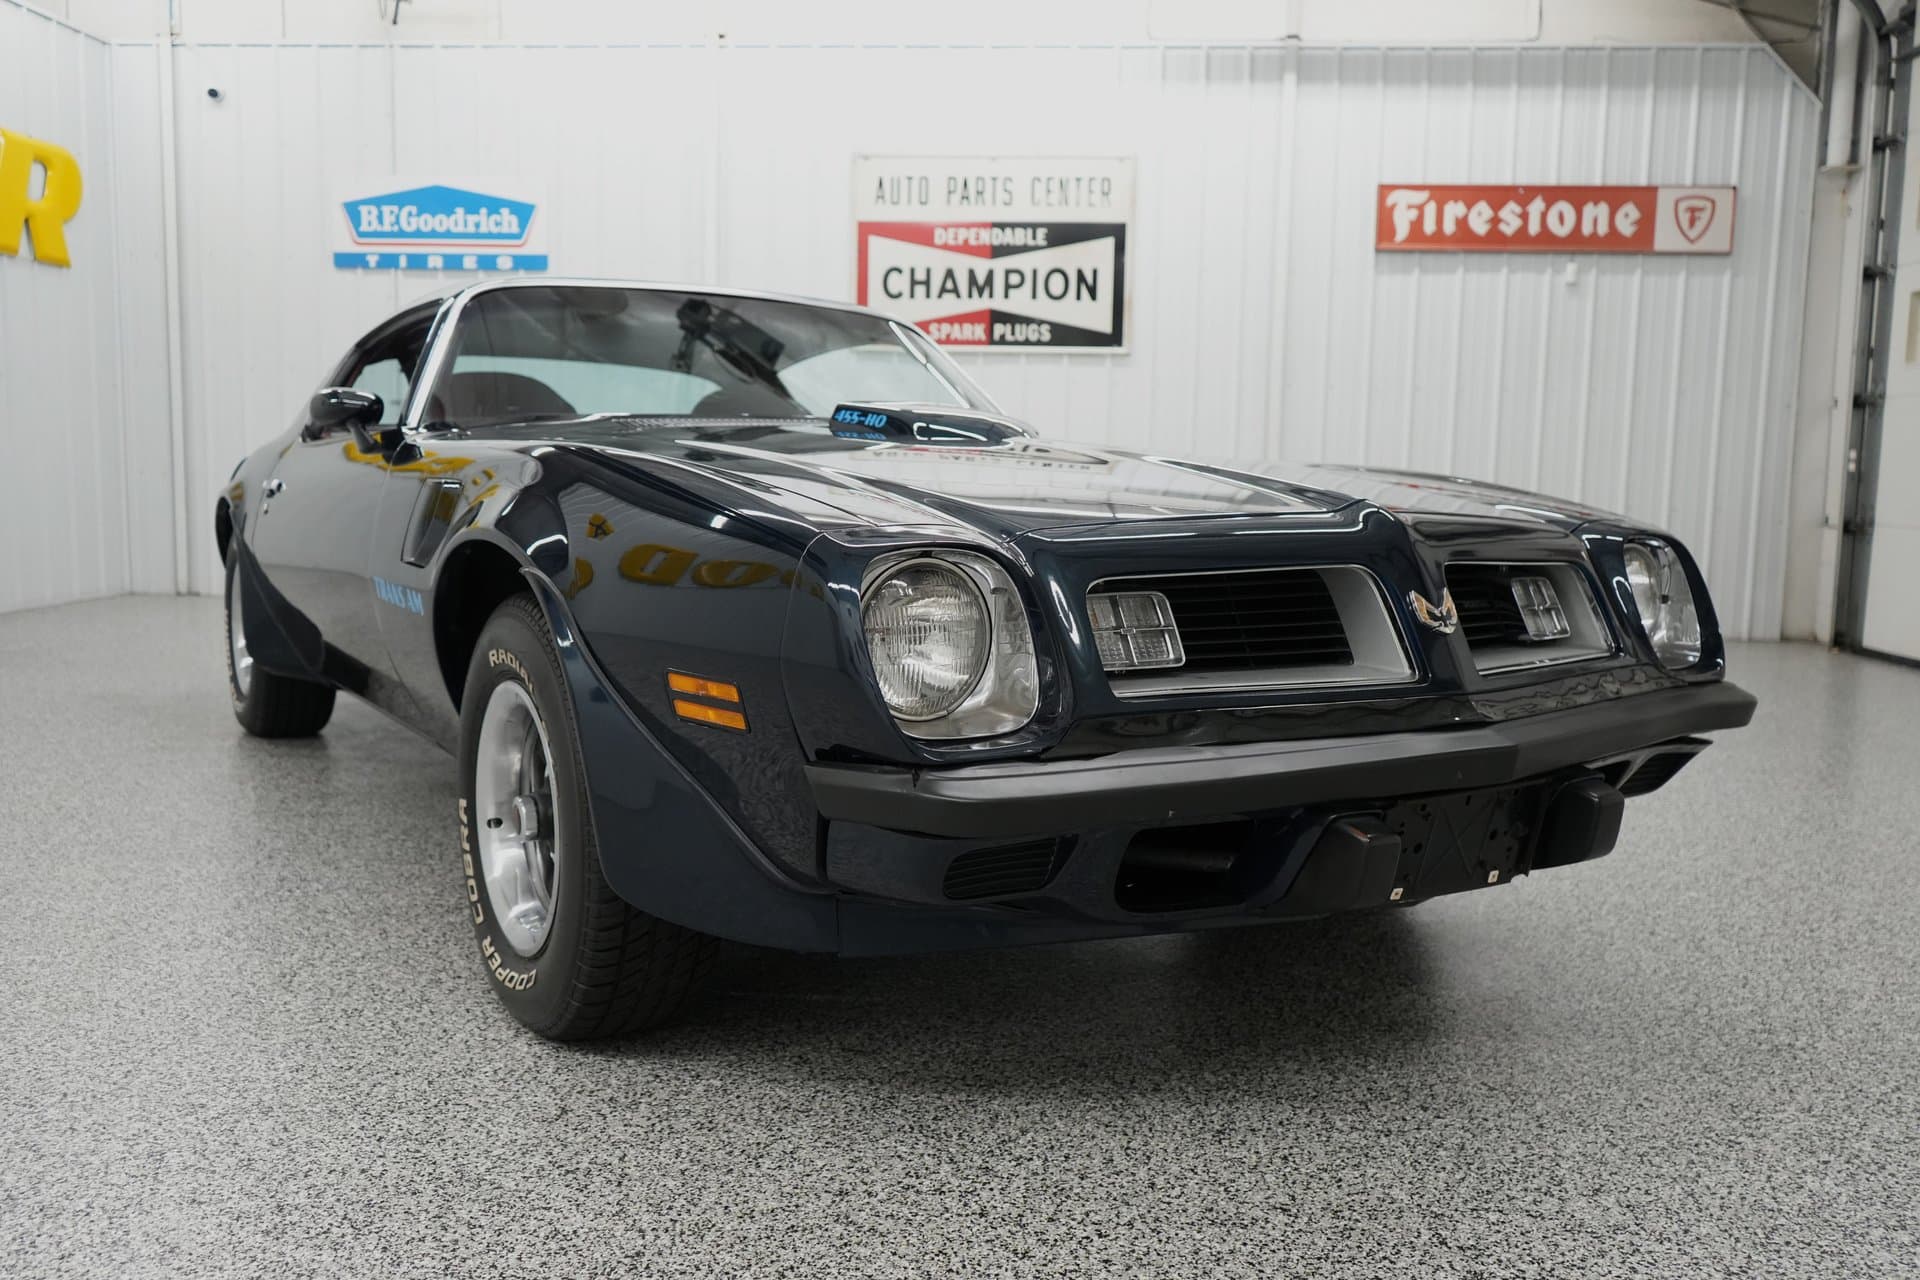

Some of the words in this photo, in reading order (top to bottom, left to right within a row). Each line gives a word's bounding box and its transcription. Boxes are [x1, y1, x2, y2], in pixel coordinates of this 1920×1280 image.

[875, 176, 930, 206] AUTO
[946, 177, 1014, 207] PARTS
[1031, 177, 1112, 208] CENTER
[1385, 188, 1641, 243] Firestone
[933, 226, 1048, 247] DEPENDABLE
[365, 253, 514, 270] TIRES
[882, 267, 1098, 302] CHAMPION
[928, 322, 987, 342] SPARK
[992, 322, 1052, 343] PLUGS
[833, 409, 888, 429] 455-HO
[458, 798, 485, 925] COBRA
[481, 935, 537, 991] COOPER
